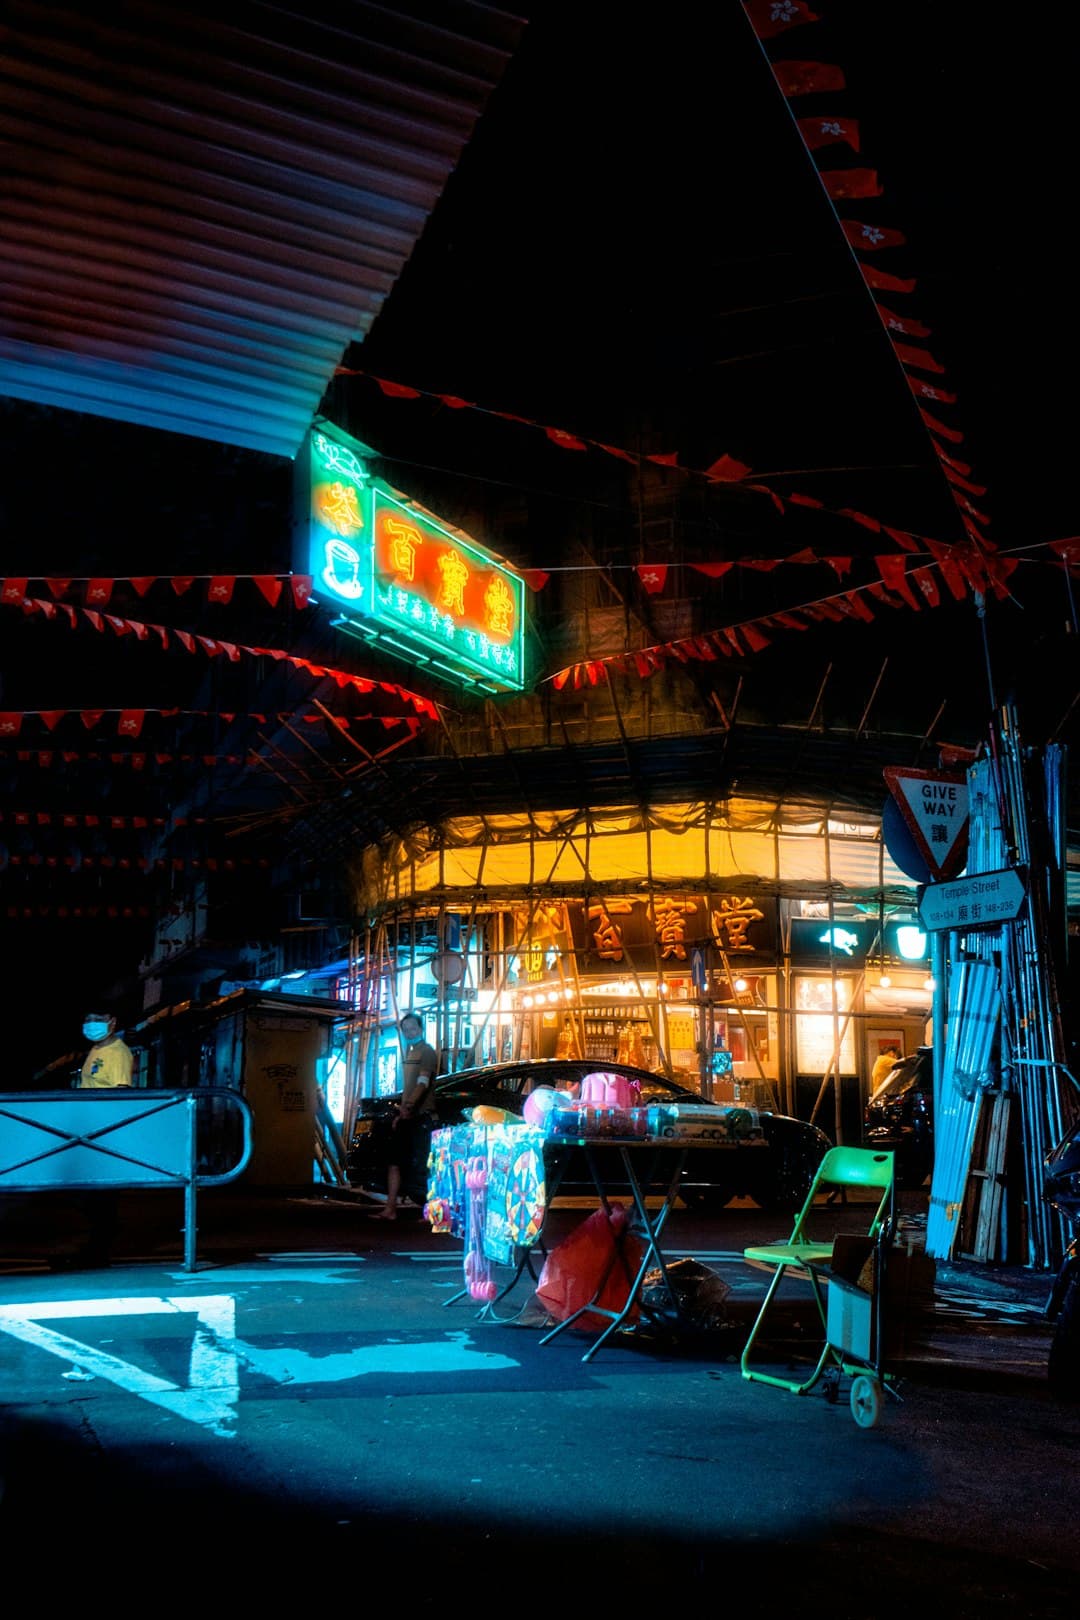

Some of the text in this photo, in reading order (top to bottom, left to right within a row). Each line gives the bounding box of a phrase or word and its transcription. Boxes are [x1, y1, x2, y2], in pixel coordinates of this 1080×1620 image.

[385, 518, 513, 637] 百寶堂
[921, 784, 957, 800] GIVE
[923, 801, 956, 817] WAY
[931, 824, 949, 844] 讓
[940, 879, 1000, 900] Temple Street
[958, 903, 982, 921] 廟街
[581, 896, 765, 962] 百寶堂
